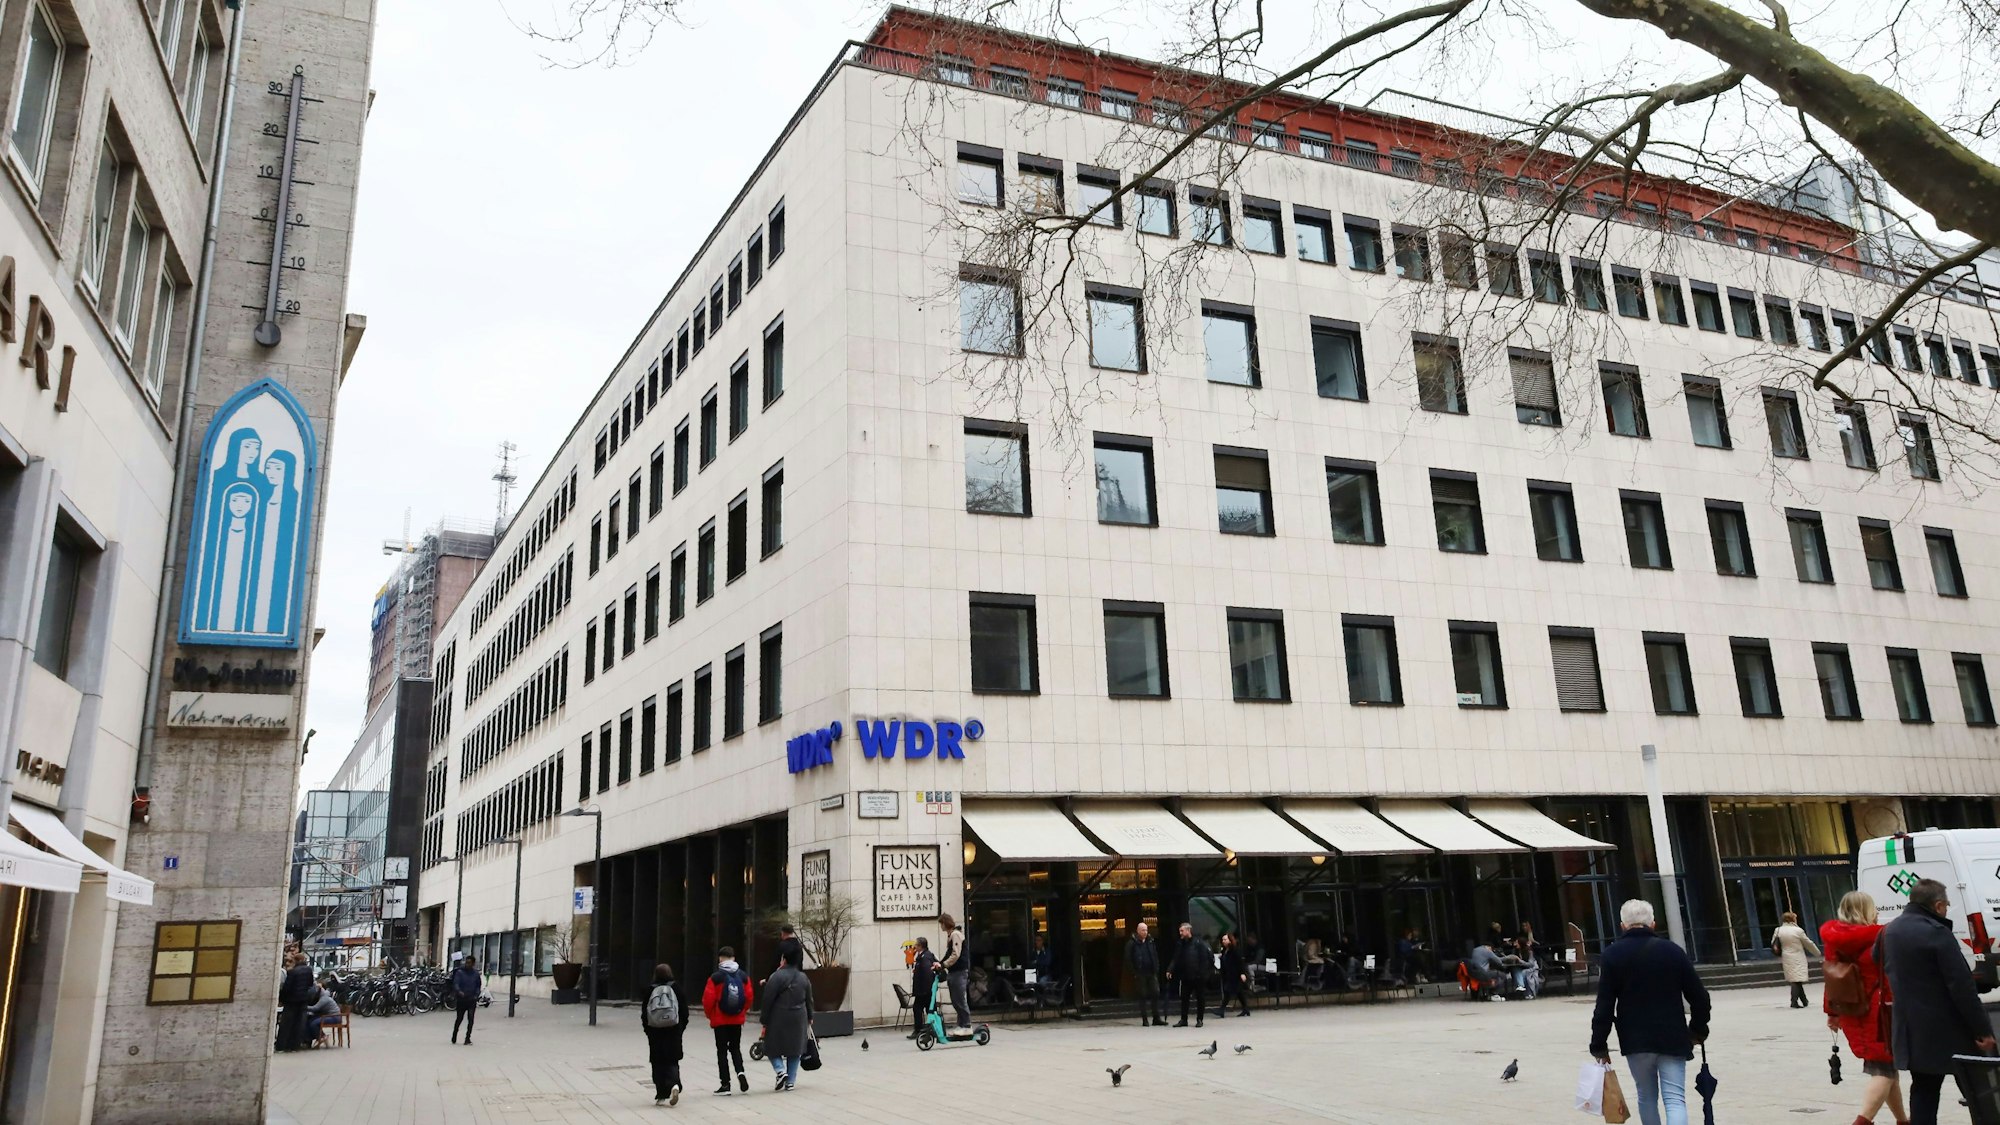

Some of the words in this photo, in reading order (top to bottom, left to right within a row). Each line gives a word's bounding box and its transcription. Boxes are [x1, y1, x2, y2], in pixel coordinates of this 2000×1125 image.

[268, 81, 283, 92] 30
[263, 122, 279, 134] 20
[259, 165, 274, 176] 10
[260, 207, 269, 217] 0
[295, 213, 303, 223] 0
[290, 256, 305, 267] 10
[286, 300, 301, 311] 20
[856, 720, 965, 760] WDR
[786, 728, 833, 774] WDR
[881, 853, 933, 870] FUNK
[805, 858, 827, 877] FUNK
[805, 878, 827, 896] HAUS
[881, 873, 934, 890] HAUS
[880, 893, 904, 902] CAFE
[915, 893, 934, 901] BAR
[880, 903, 934, 913] RESTAURANT
